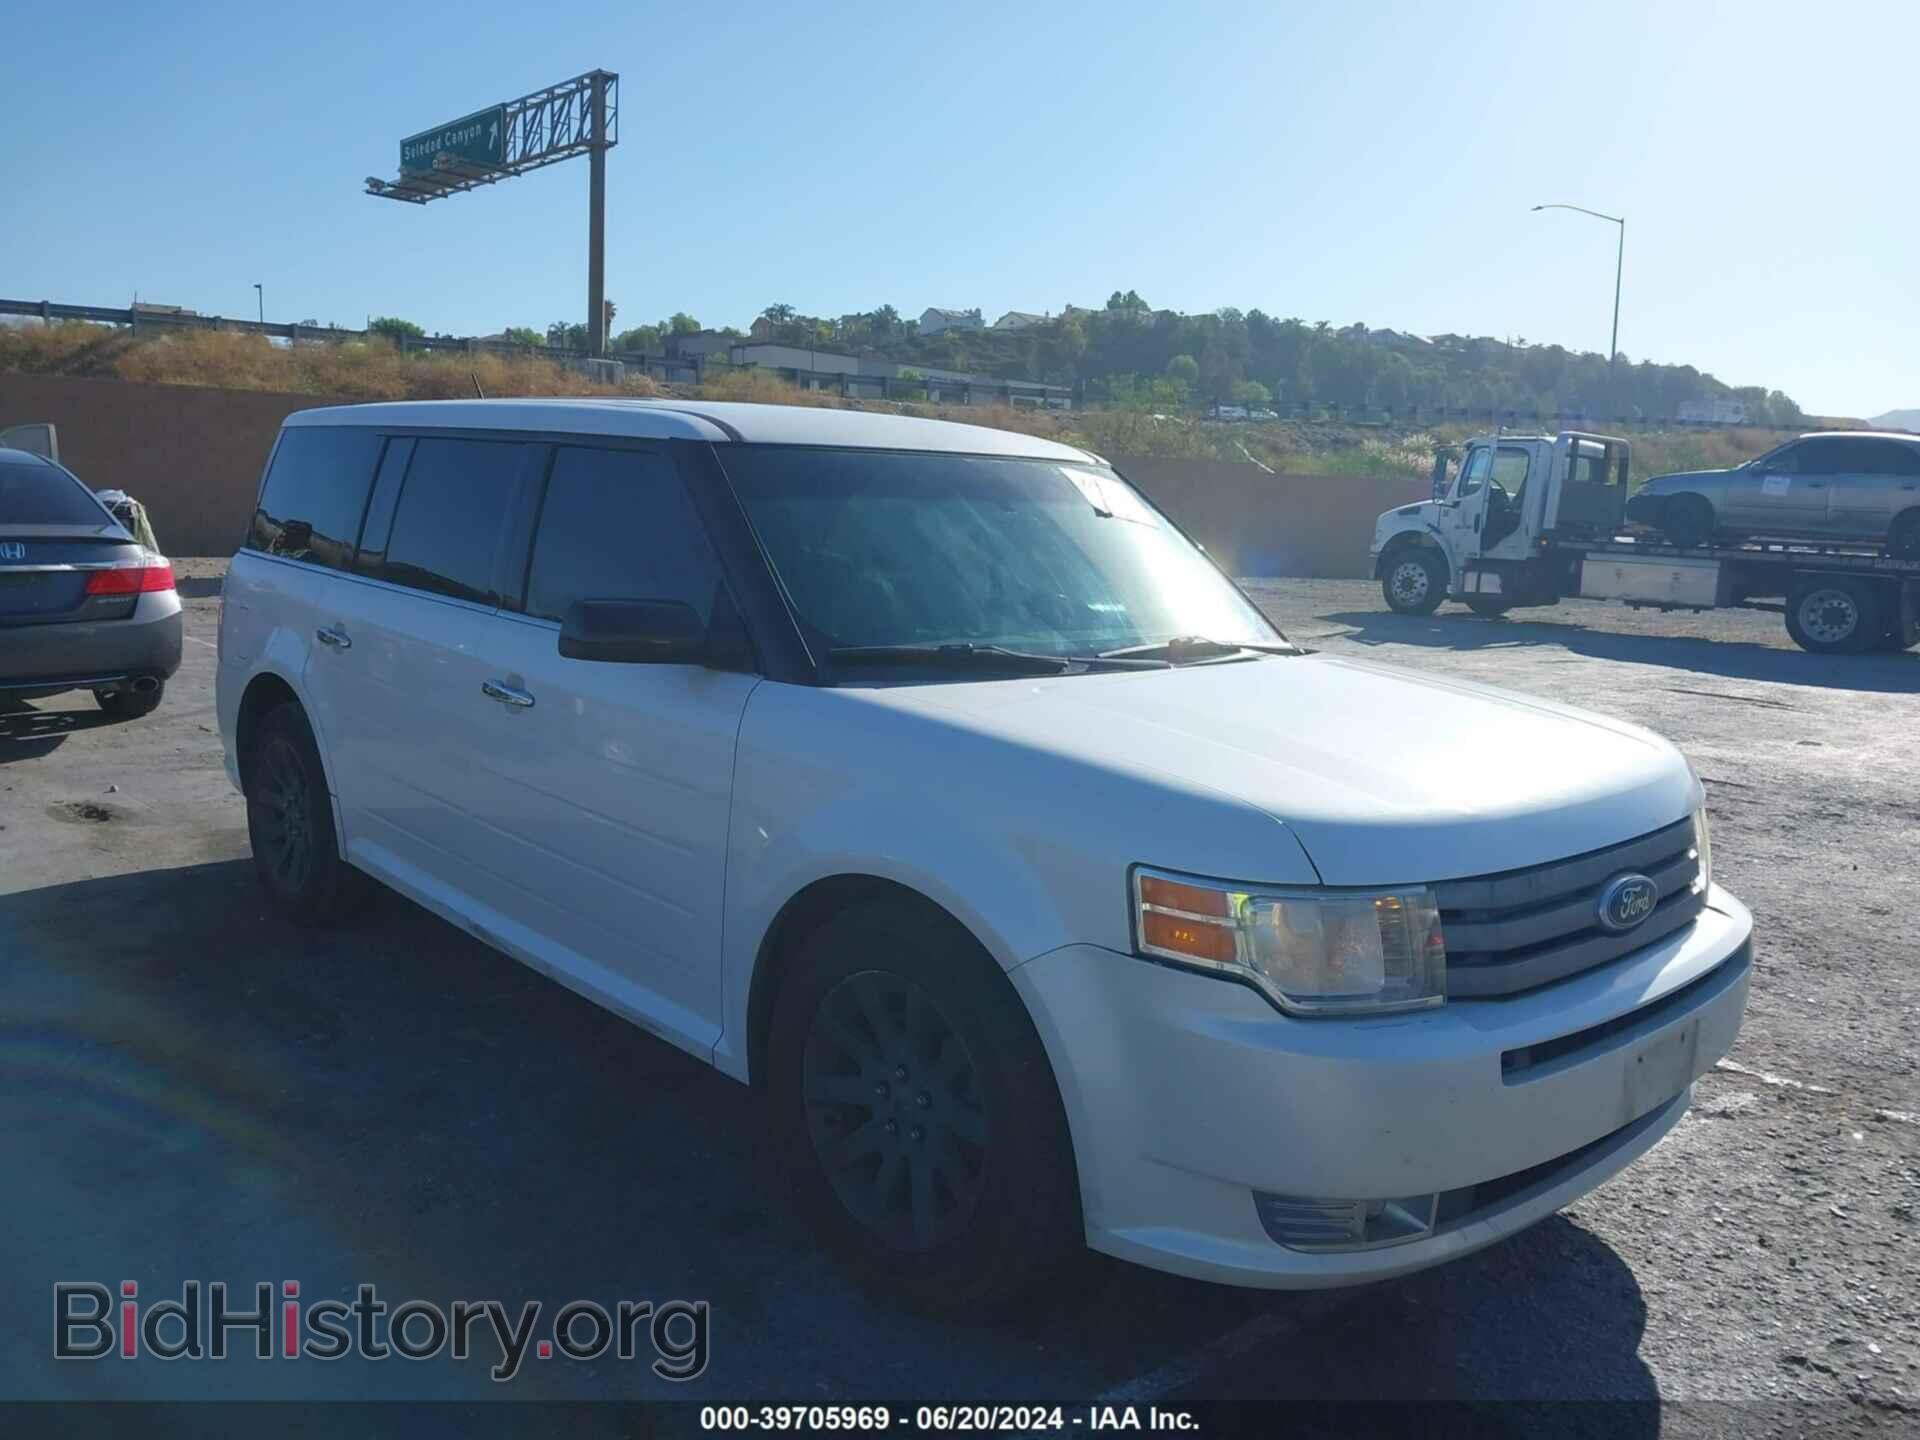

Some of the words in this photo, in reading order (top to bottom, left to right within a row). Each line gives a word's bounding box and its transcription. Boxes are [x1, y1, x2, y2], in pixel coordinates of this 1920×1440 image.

[404, 136, 441, 160] Soledad
[444, 124, 482, 146] Canyon
[1620, 885, 1650, 919] Ford
